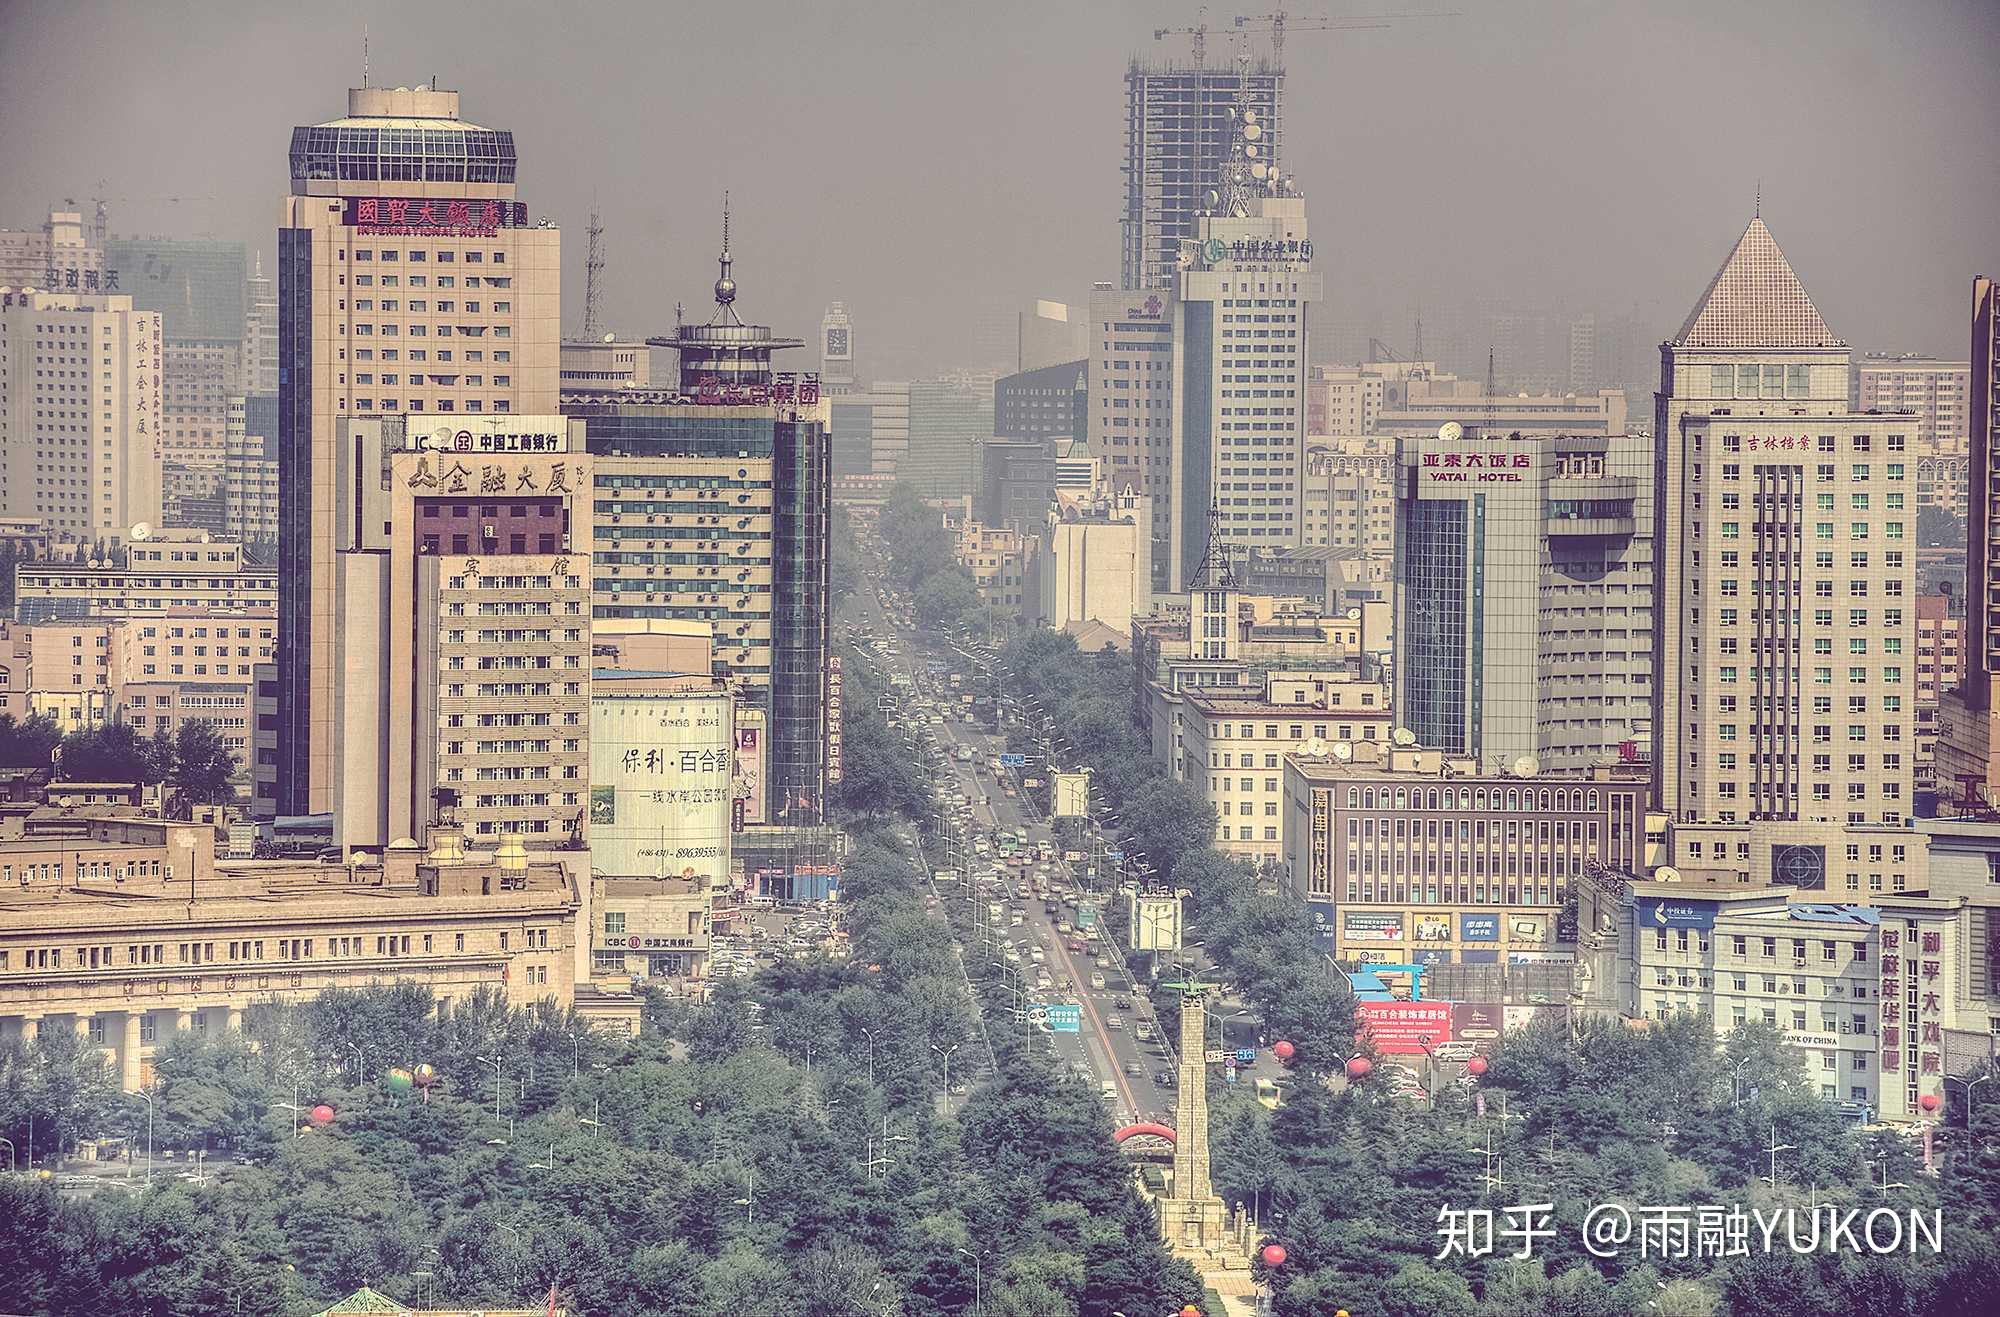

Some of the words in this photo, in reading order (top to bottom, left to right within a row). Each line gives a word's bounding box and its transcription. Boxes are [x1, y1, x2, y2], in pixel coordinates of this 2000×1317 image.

[459, 227, 498, 237] HOTEL
[136, 316, 148, 436] 吉林工会大厦
[480, 434, 558, 450] 中国工商银行
[1748, 435, 1811, 451] 吉林档案
[1423, 454, 1530, 468] 亚泰大饭店
[442, 460, 573, 494] 金融大厦
[1430, 472, 1467, 481] YATAI
[1478, 473, 1522, 482] HOTEL
[604, 938, 626, 947] ICBC
[644, 938, 693, 947] 中国工商银行
[1802, 1036, 1813, 1044] OF
[1814, 1037, 1838, 1046] CHINA
